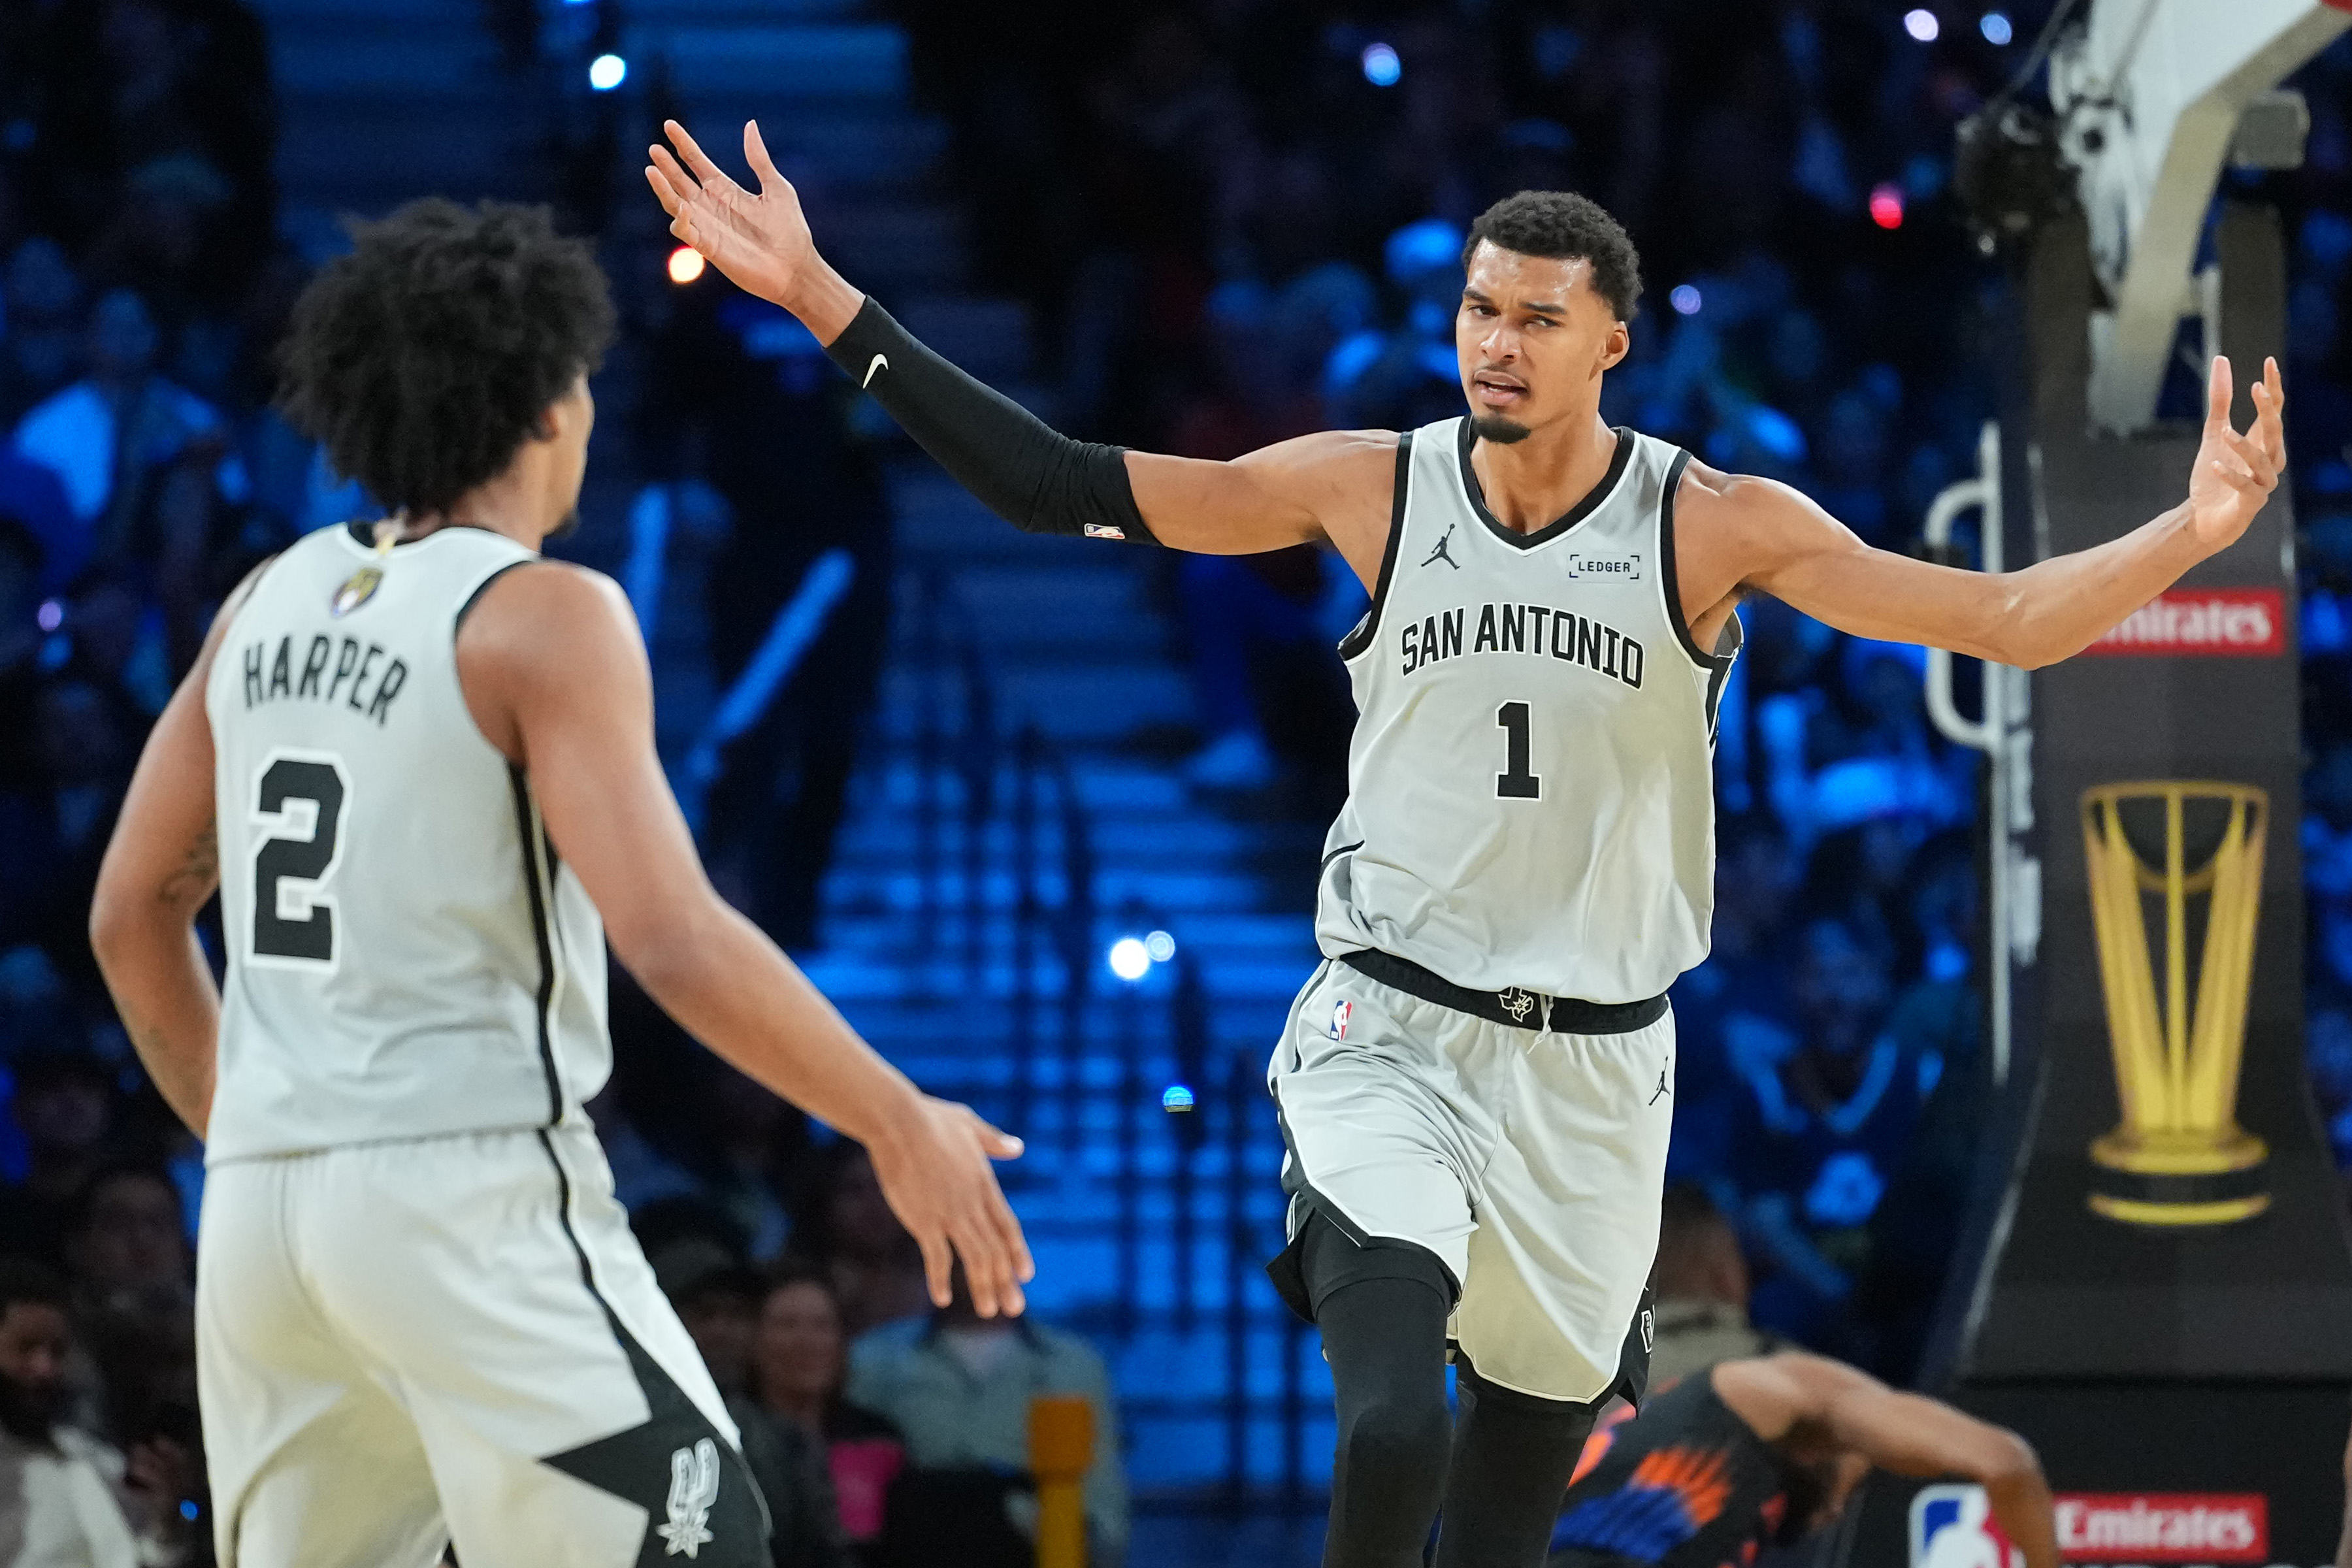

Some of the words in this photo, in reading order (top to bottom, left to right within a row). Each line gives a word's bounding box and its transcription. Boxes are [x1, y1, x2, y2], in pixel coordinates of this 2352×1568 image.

[1578, 561, 1631, 572] LEDGER
[1401, 606, 1466, 679] SAN
[1471, 602, 1645, 692] ANTONIO
[2099, 595, 2272, 643] mirates
[243, 632, 409, 727] HARPER
[1494, 699, 1542, 802] 1
[244, 748, 351, 972] 2
[2055, 1500, 2254, 1549] Emirates
